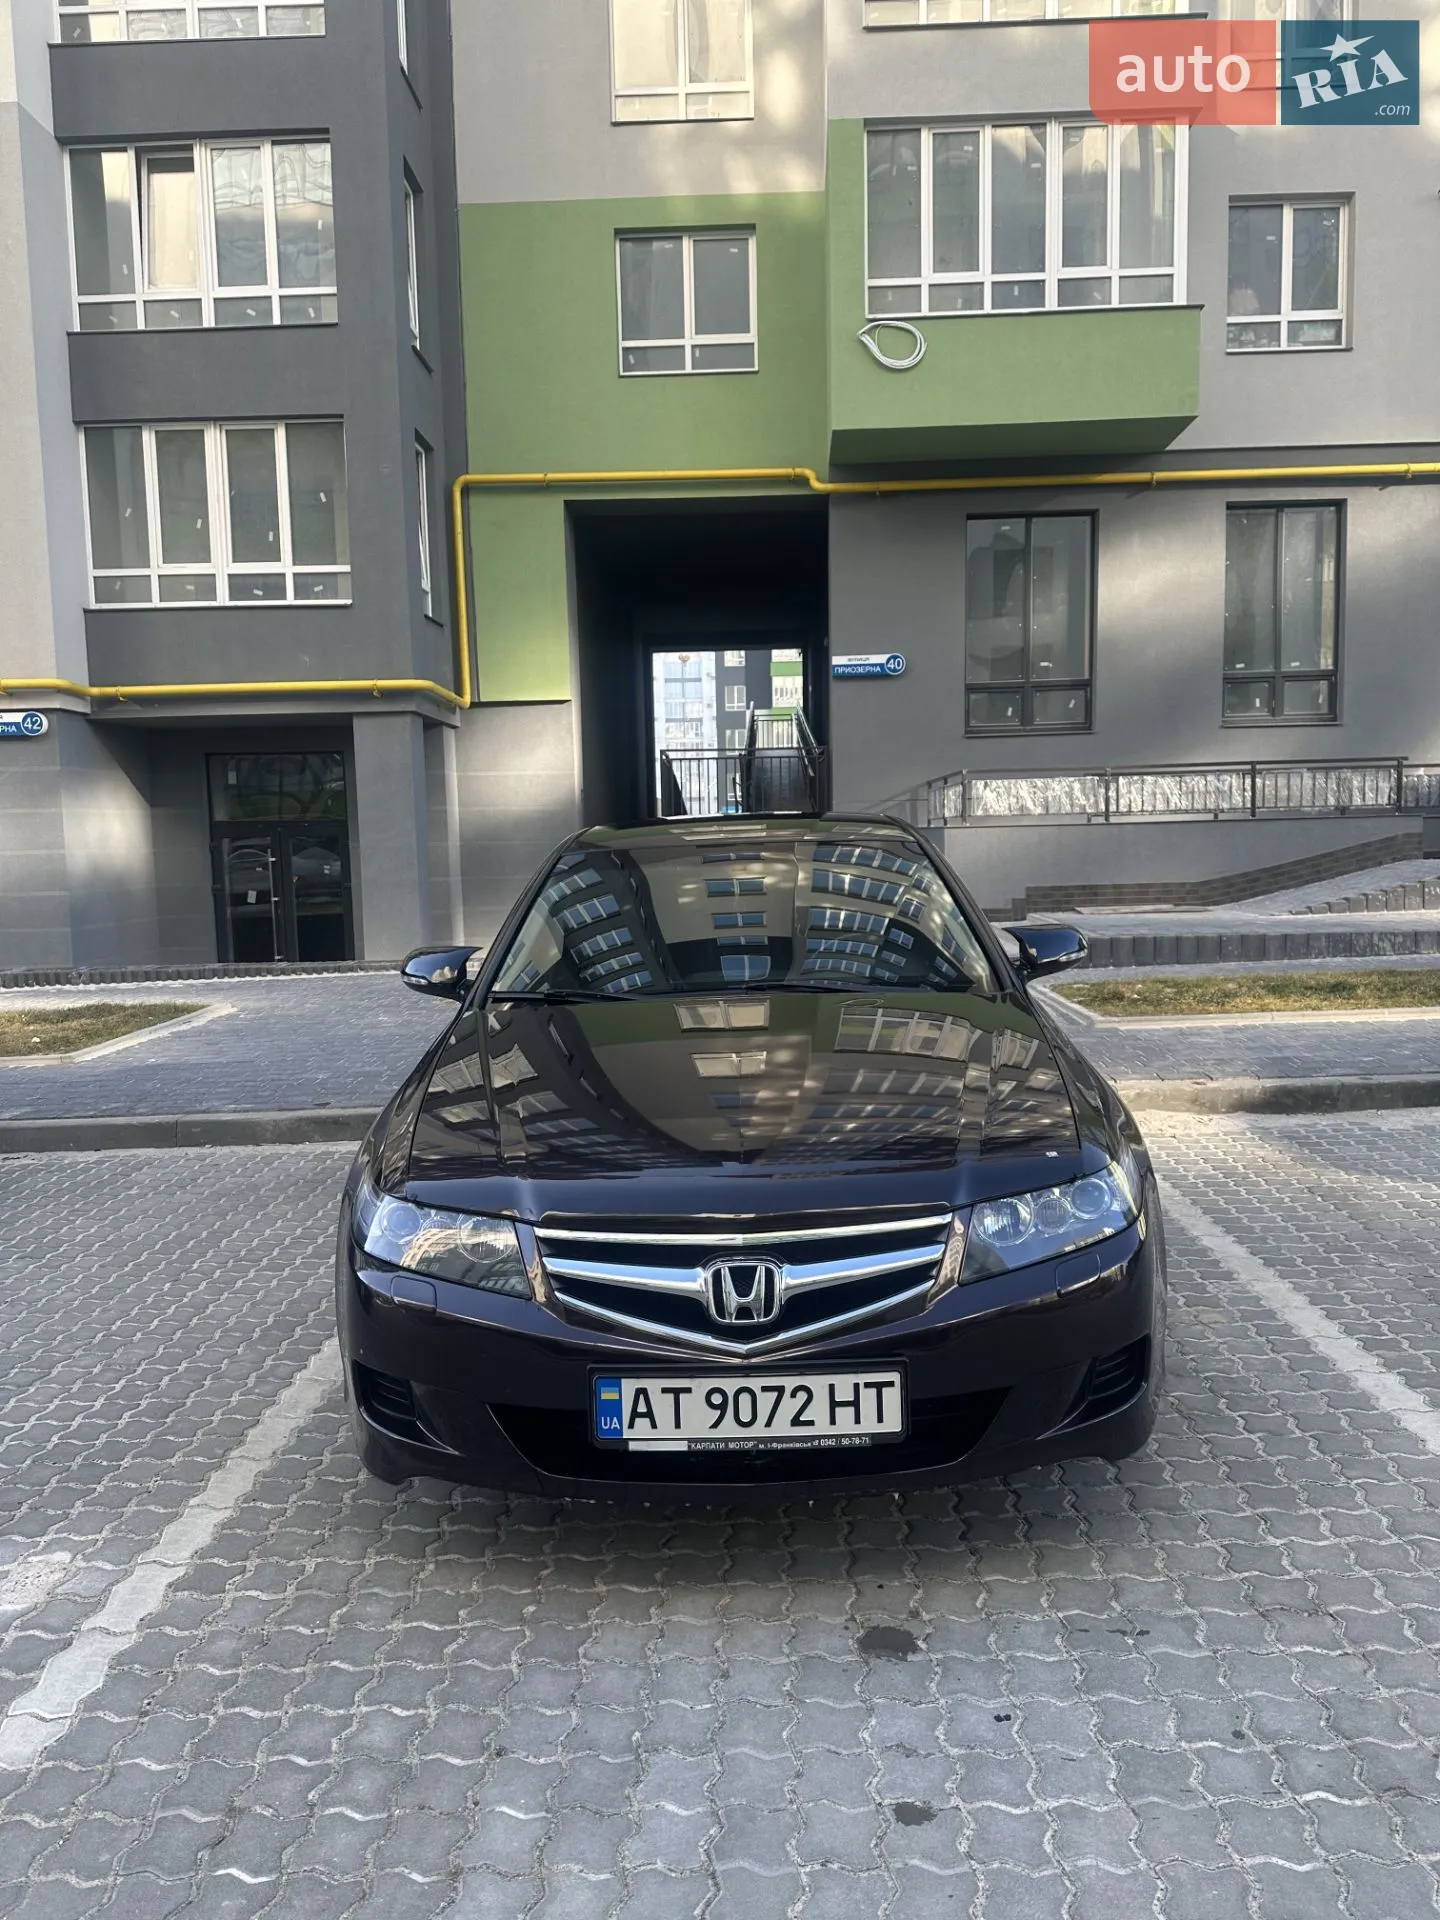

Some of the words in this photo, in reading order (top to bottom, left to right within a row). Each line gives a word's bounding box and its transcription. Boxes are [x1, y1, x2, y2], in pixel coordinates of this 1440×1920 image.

[834, 665, 882, 674] ПРИОЗЕРНА
[887, 658, 903, 670] 40
[24, 716, 42, 730] 42
[627, 1386, 693, 1430] AT
[704, 1384, 815, 1430] 9072
[828, 1380, 896, 1426] HT
[601, 1416, 620, 1430] UA
[820, 1438, 836, 1446] 0342
[841, 1436, 869, 1445] 50-78-71
